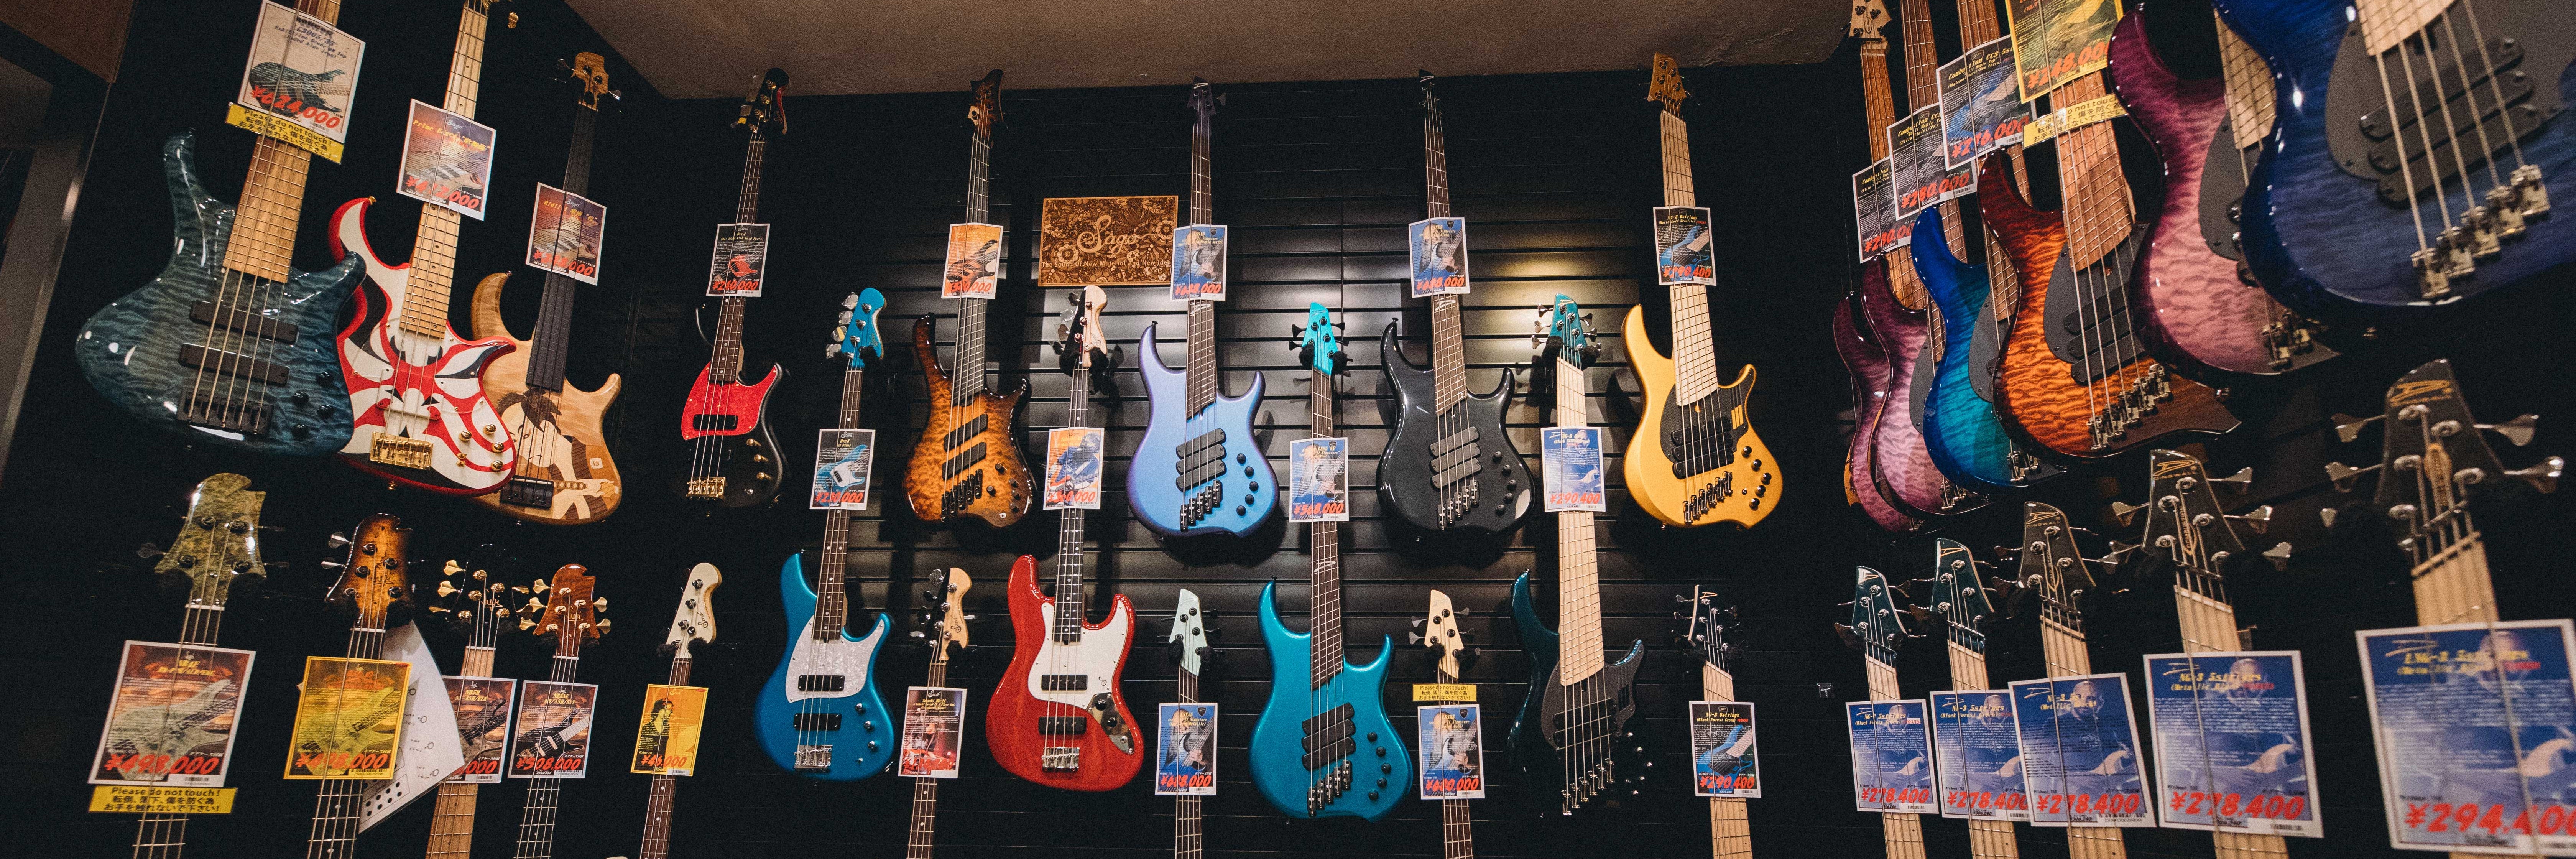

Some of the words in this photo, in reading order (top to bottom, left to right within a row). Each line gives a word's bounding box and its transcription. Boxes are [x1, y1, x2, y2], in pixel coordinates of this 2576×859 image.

[276, 118, 286, 127] do
[288, 124, 303, 133] not
[413, 120, 434, 131] Prime
[1077, 215, 1154, 255] Sago
[641, 755, 687, 768] ¥46,000
[111, 787, 146, 796] Please
[1861, 787, 1929, 804] ¥278,400
[2037, 794, 2139, 814] ¥278,400
[2170, 791, 2304, 820] ¥278,400
